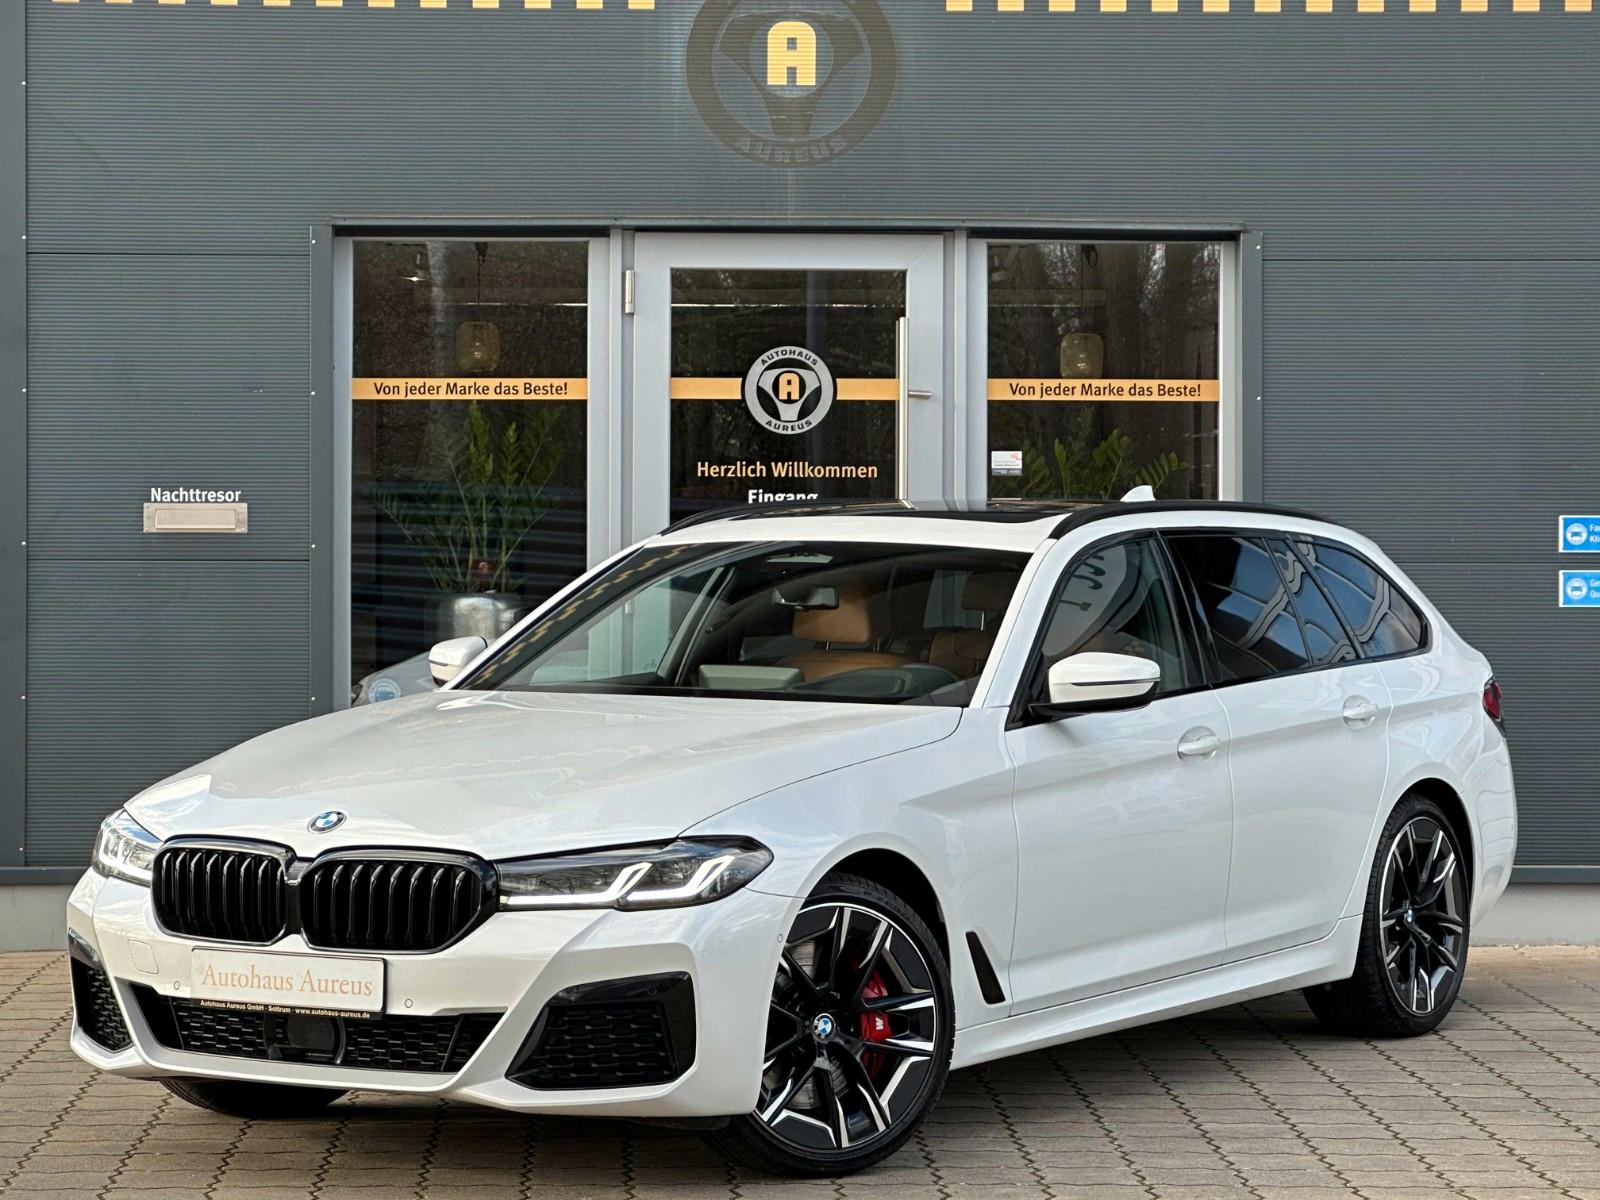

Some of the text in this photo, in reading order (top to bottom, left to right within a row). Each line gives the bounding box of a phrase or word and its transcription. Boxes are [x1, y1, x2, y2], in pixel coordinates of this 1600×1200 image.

[767, 21, 816, 86] A
[761, 349, 818, 366] AUTOHAUS
[373, 381, 568, 398] Von jeder Marke das Beste!
[778, 372, 800, 400] A
[1009, 383, 1201, 399] Von jeder Marke das Beste!
[765, 419, 812, 432] AUREUS
[697, 461, 878, 478] Herzlich Willkommen
[150, 487, 242, 502] Nachttresor
[202, 963, 373, 996] Autohaus Aureus
[200, 1000, 226, 1008] Autohaus
[226, 1002, 246, 1010] Aureus
[246, 1003, 264, 1011] GmbH
[295, 1008, 371, 1019] www.autohaus-aureus.de
